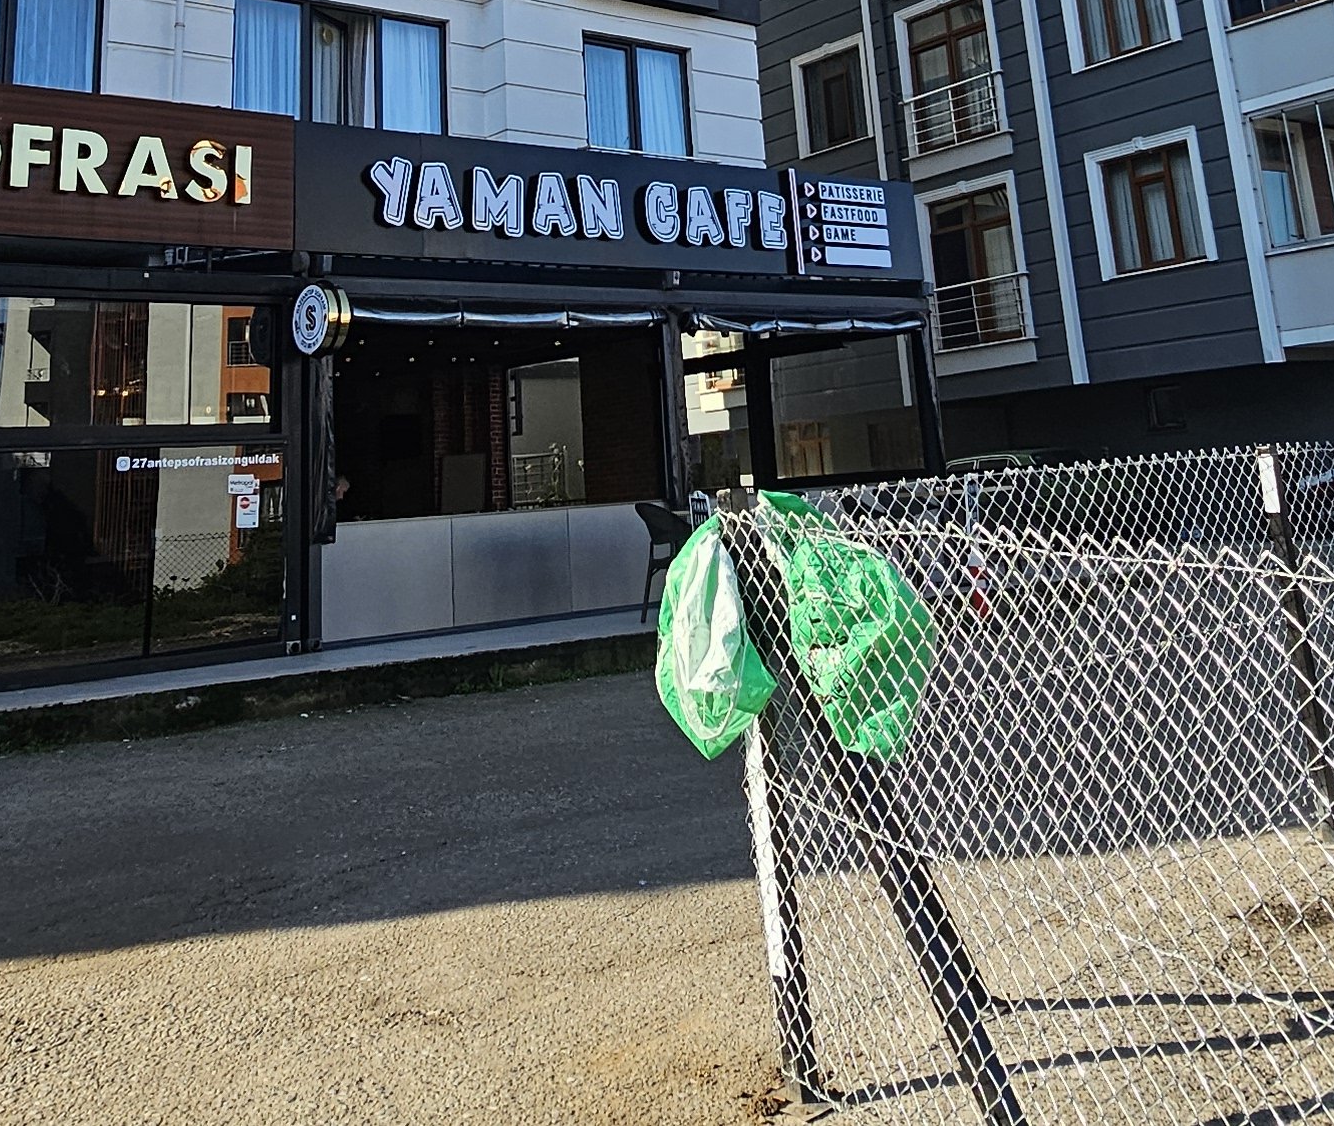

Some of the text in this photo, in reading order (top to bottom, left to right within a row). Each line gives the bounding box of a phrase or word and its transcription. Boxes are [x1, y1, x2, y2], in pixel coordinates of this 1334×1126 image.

[820, 184, 884, 202] PATISSERIE
[370, 157, 788, 251] YAMAN CAFE
[823, 205, 879, 223] FASTFOOD
[825, 227, 857, 241] GAME
[131, 454, 280, 470] 27antepsofrasizonguldak
